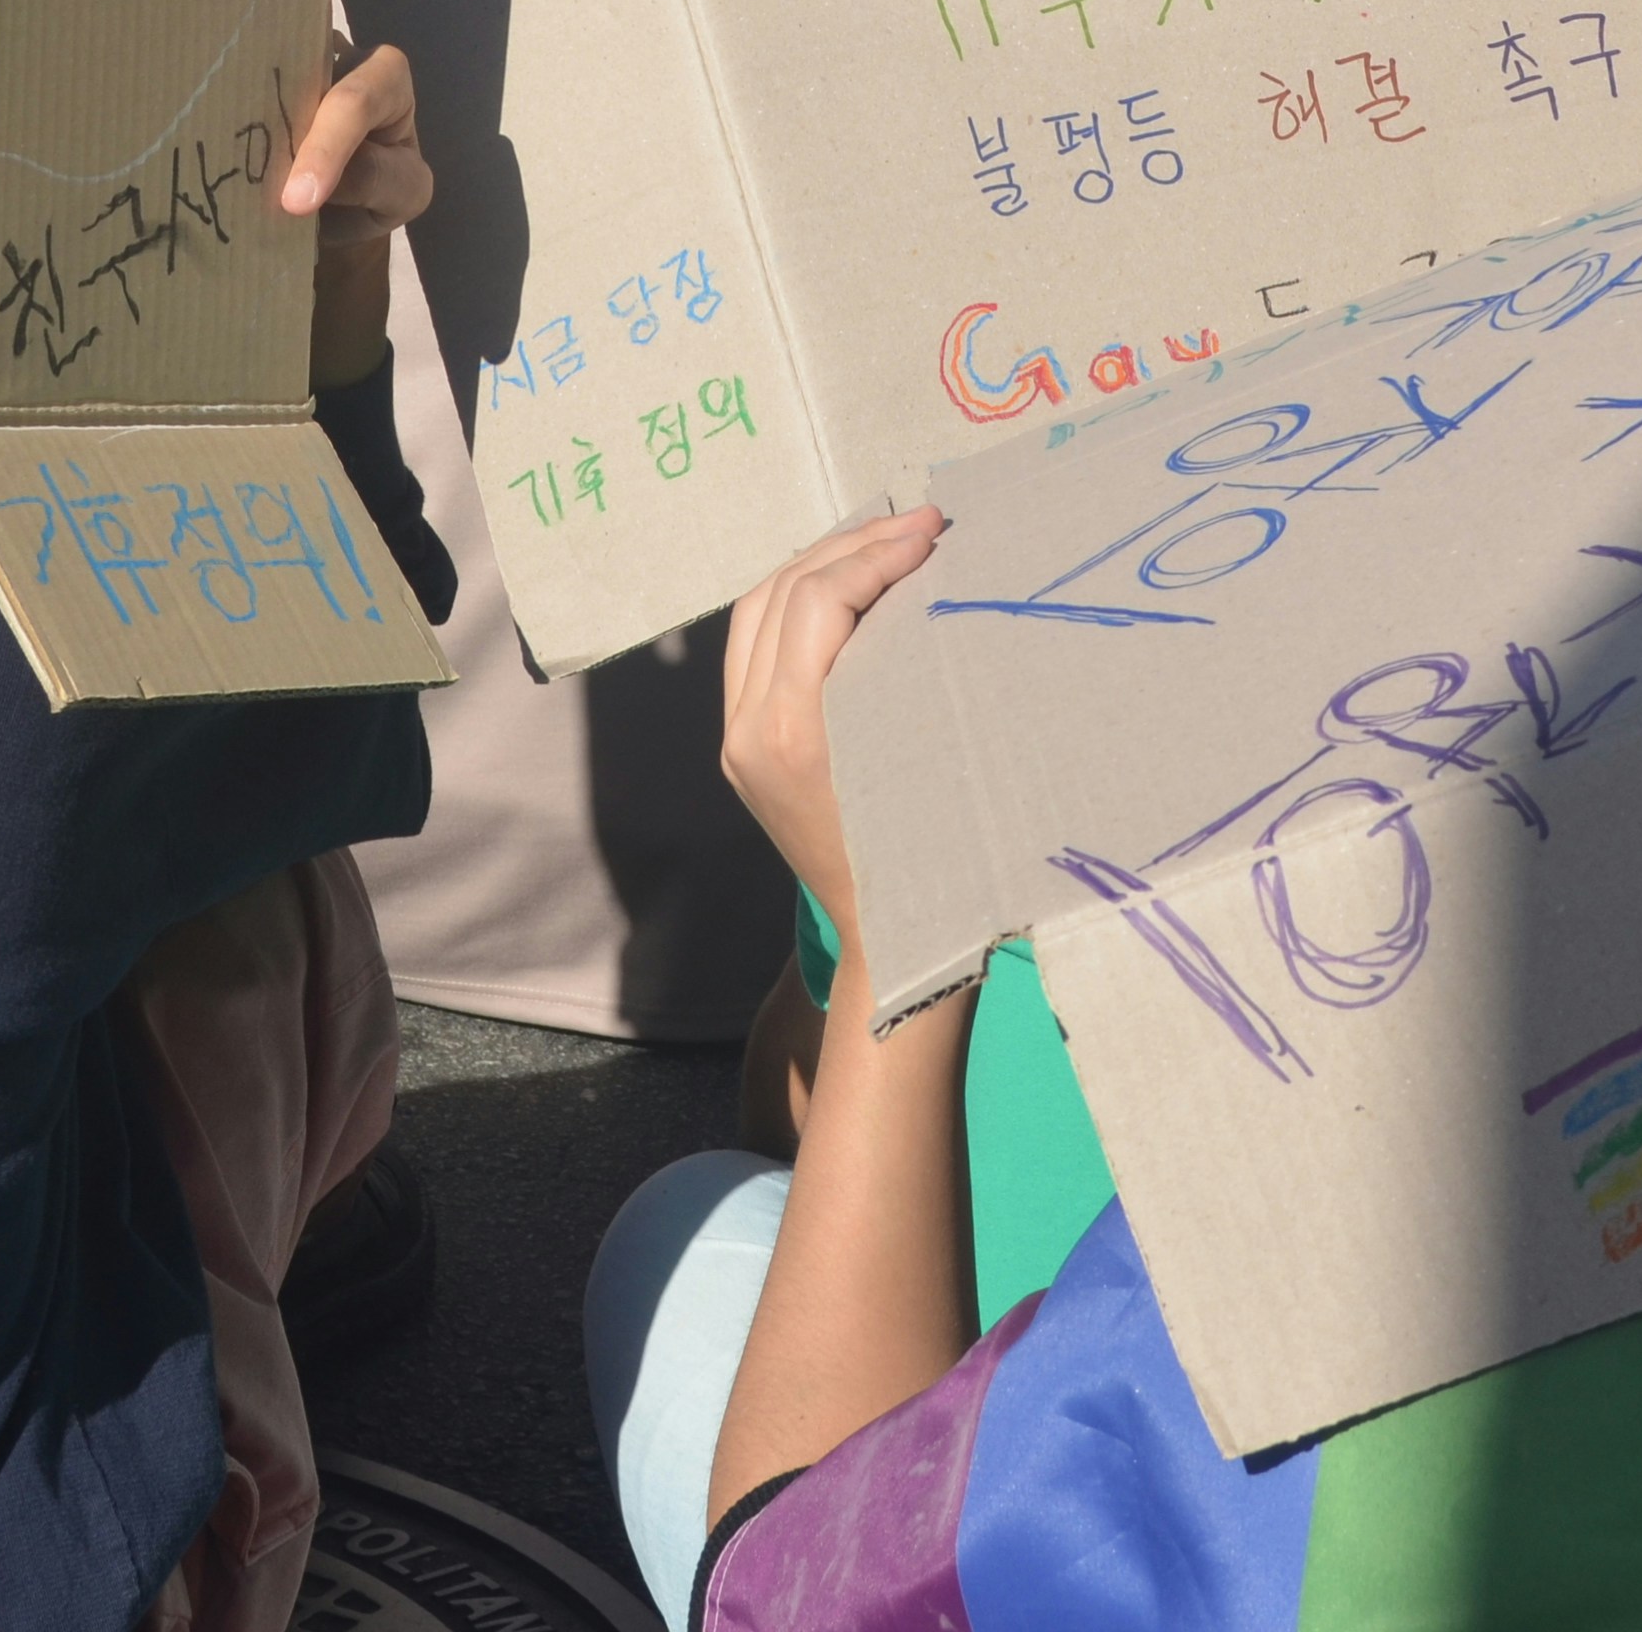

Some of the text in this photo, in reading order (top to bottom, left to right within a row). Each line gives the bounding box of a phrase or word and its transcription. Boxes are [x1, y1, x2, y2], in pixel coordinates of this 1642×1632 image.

[967, 89, 1184, 216] 불평등
[1258, 52, 1427, 144] 해결
[507, 375, 757, 527] 기후 정의
